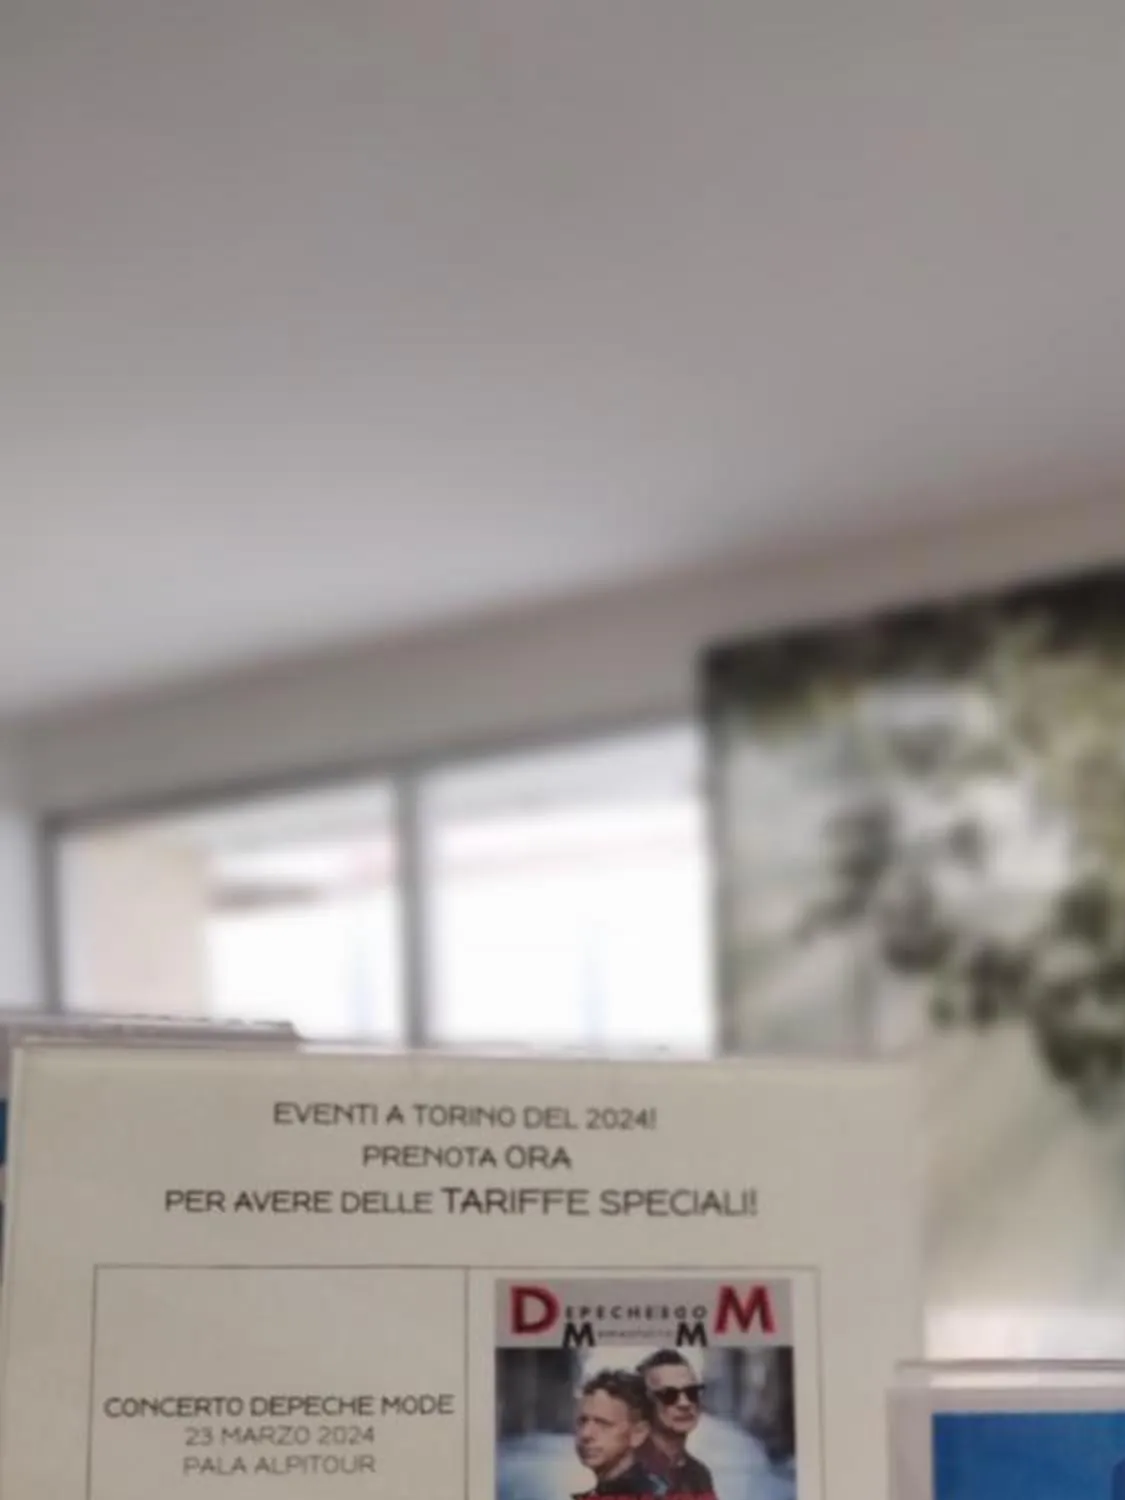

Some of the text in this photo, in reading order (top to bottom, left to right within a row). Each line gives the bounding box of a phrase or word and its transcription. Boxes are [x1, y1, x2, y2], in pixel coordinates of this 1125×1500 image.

[273, 1101, 657, 1131] EVENTI A TORINO DEL 2024!
[362, 1144, 572, 1170] PRENOTA ORA
[164, 1186, 757, 1217] PER AVERE DELLE TARIFFE SPECIALI!
[103, 1393, 455, 1419] CONCERTO DEPECHE MODE
[184, 1424, 375, 1447] 23 MARZO 2024
[182, 1454, 376, 1476] PALA ALPITOUR
